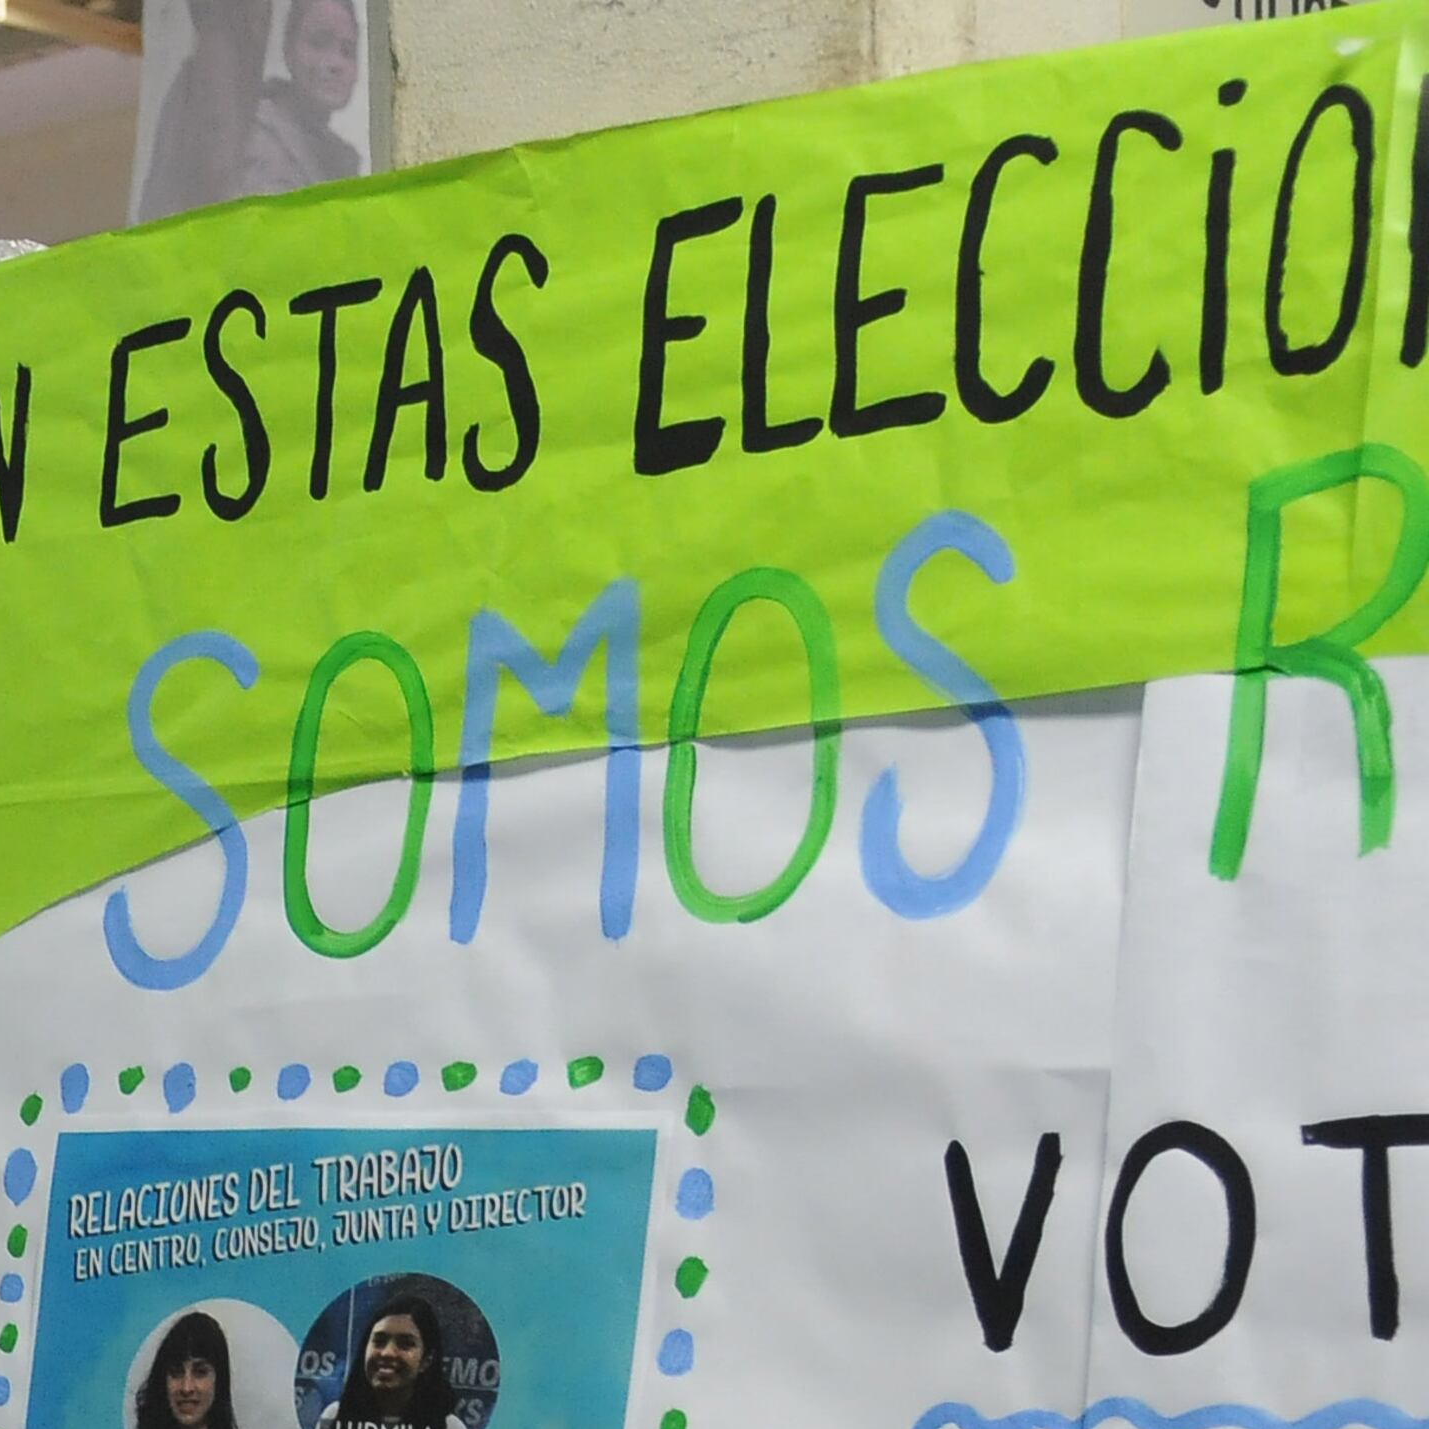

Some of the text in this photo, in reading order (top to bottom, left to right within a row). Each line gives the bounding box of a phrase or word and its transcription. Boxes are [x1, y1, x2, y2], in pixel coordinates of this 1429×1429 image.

[100, 234, 548, 527] ESTAS
[103, 508, 1027, 992] SOMOS
[68, 1142, 464, 1240] RELACIONES DEL TRABAJO
[73, 1182, 587, 1282] EN CENTRO, CONSEJO, JUNTA Y DIRECTOR
